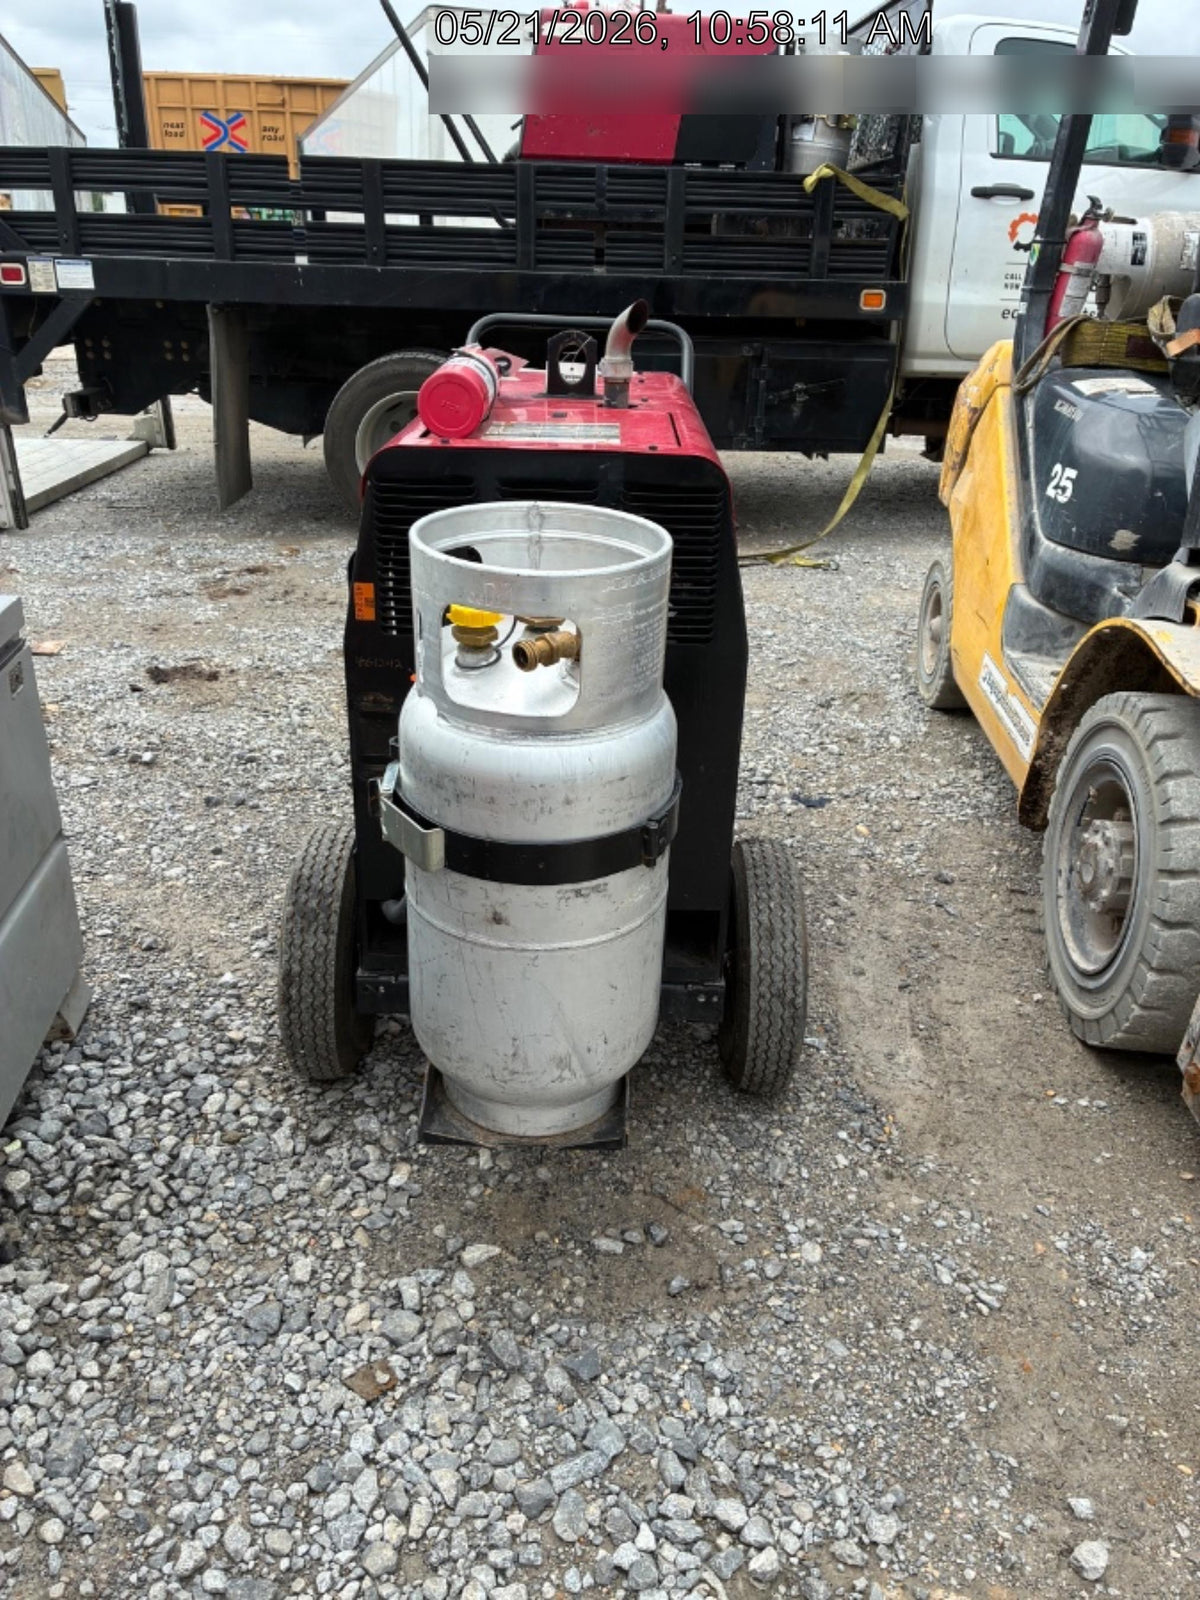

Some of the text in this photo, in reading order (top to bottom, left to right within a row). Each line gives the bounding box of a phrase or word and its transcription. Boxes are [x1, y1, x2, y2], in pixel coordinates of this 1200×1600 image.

[262, 125, 280, 134] any
[262, 134, 285, 142] road
[1045, 462, 1079, 504] 25
